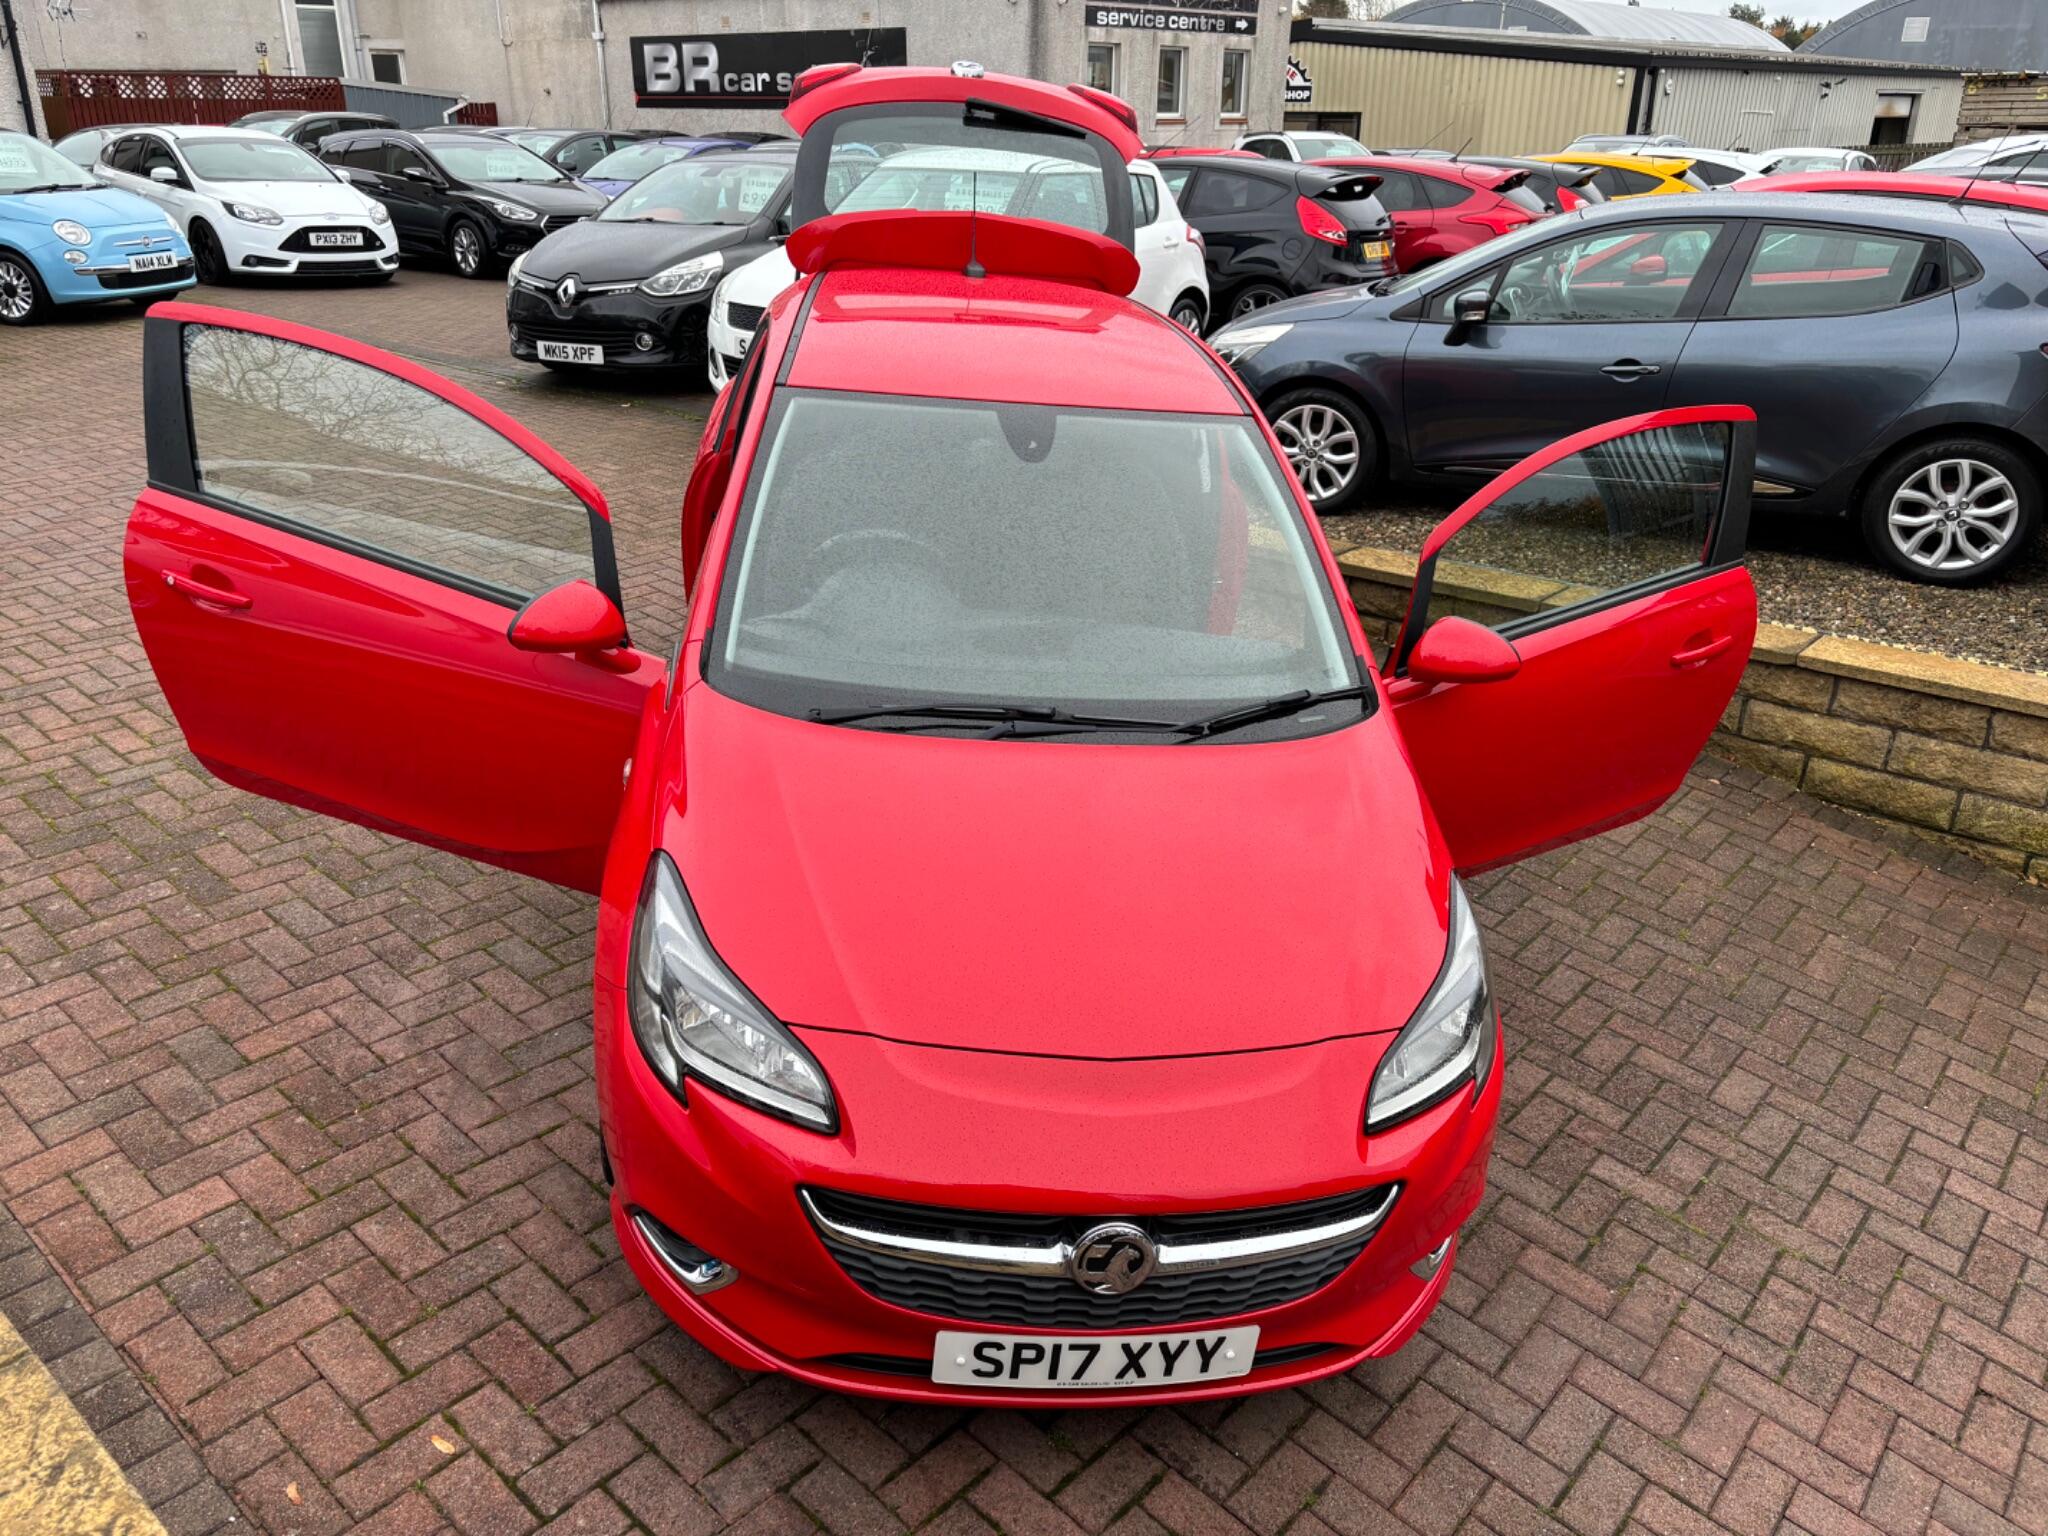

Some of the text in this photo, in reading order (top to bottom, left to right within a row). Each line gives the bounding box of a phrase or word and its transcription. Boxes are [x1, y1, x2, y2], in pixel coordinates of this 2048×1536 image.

[1096, 9, 1226, 31] service centre
[643, 42, 721, 93] BR
[723, 72, 770, 92] car
[315, 233, 358, 245] PX13 ZHY
[135, 254, 173, 270] NA14 XLM
[543, 343, 595, 361] MK15 XPF
[971, 1336, 1227, 1381] SP17 XYY
